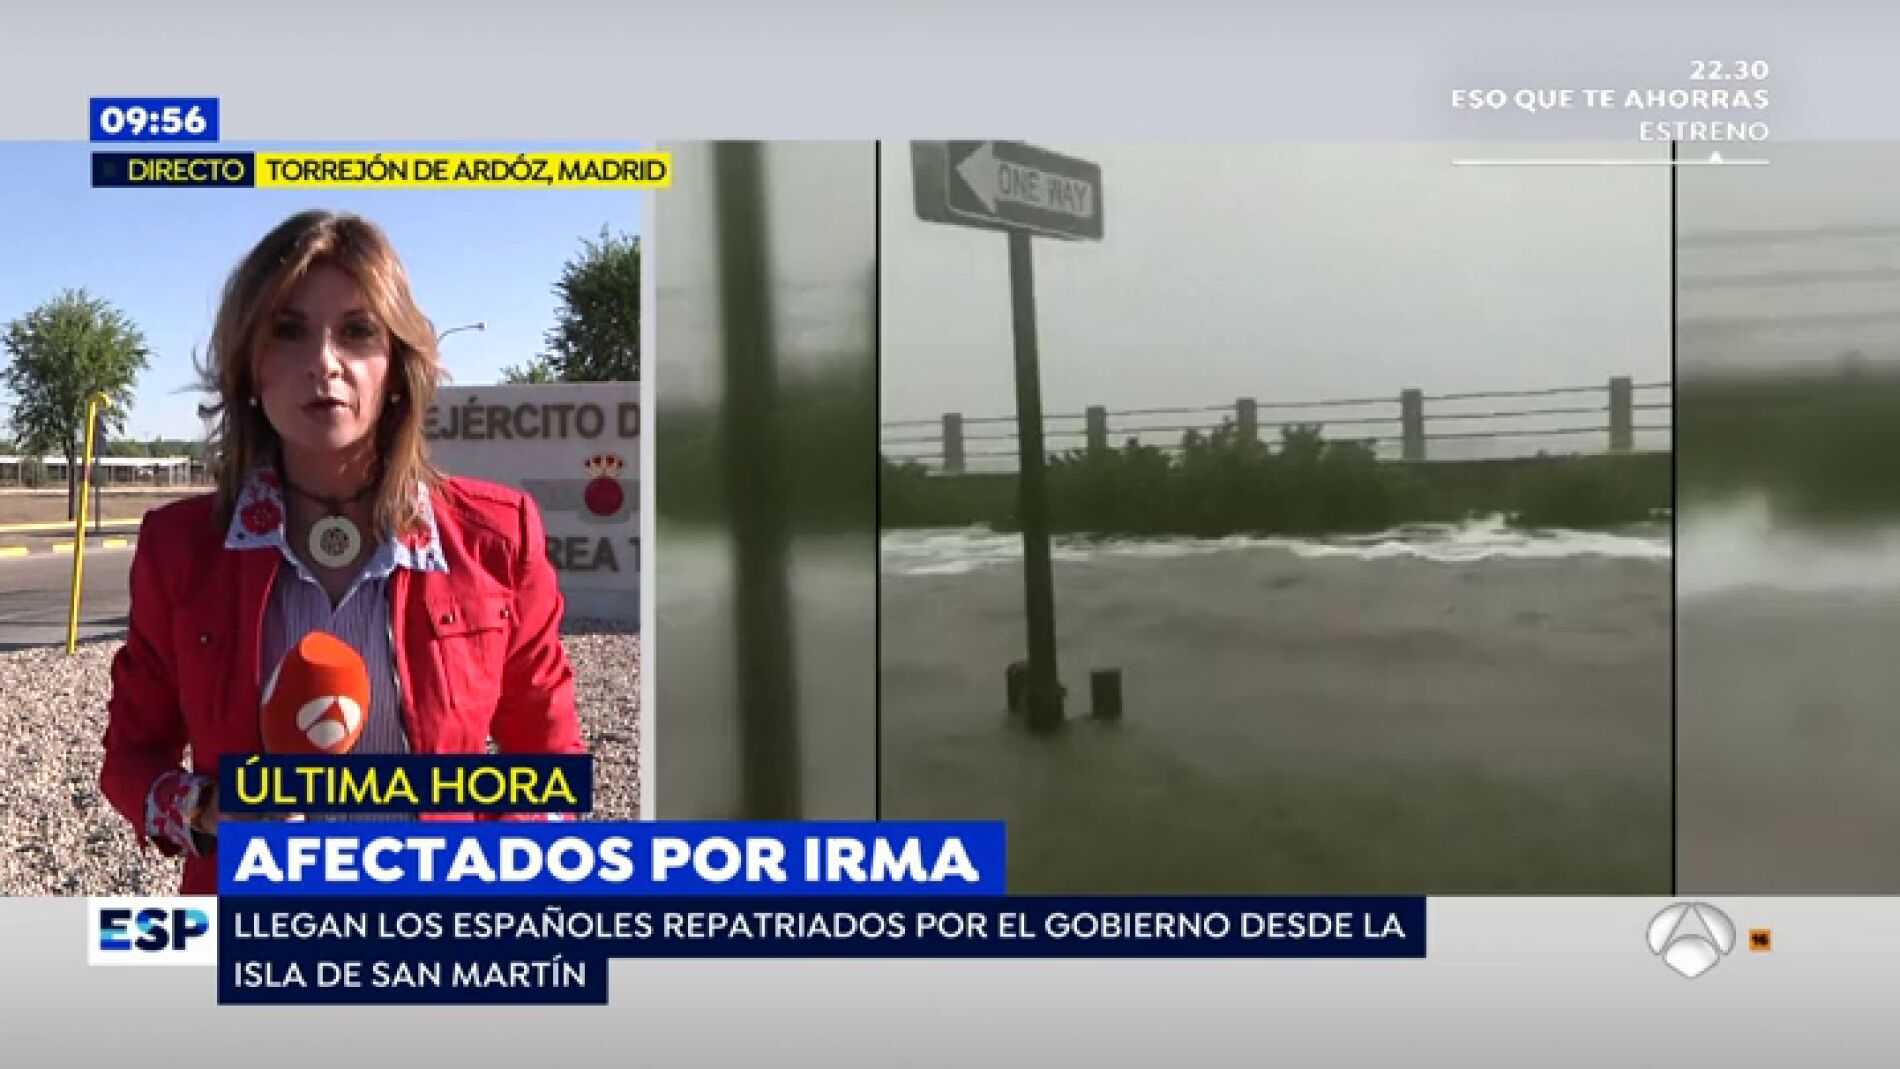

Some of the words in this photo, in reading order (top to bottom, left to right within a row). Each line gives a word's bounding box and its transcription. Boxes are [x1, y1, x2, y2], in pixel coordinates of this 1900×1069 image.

[998, 163, 1041, 202] ONE
[1048, 177, 1089, 213] WAY
[422, 395, 605, 440] EJÉRCITO
